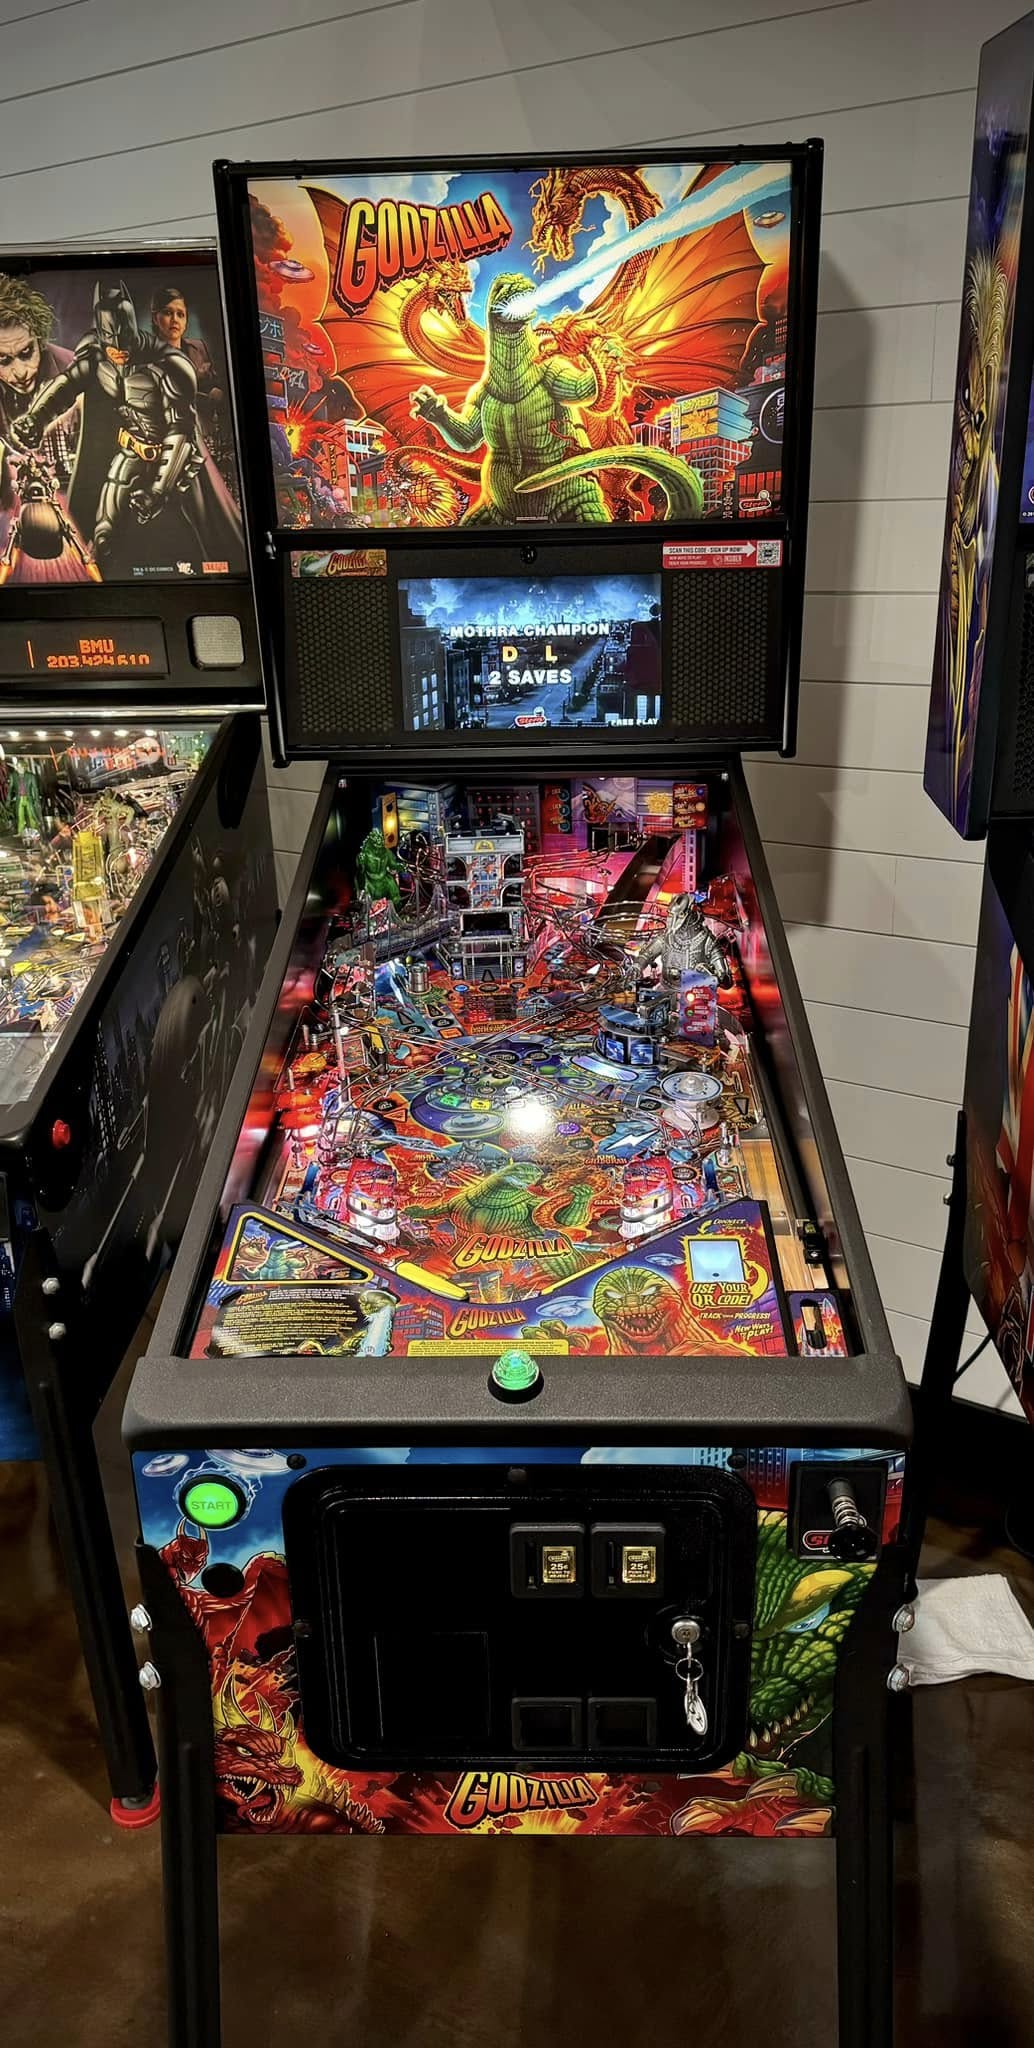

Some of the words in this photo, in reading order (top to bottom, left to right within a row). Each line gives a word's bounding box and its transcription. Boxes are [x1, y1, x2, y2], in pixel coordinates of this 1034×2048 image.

[335, 192, 513, 313] GODZILLA
[450, 625, 517, 638] MOTHRA
[523, 623, 610, 637] CHAMPION
[79, 639, 115, 653] BMU
[502, 646, 518, 663] D
[545, 645, 558, 663] L
[489, 670, 502, 685] 2
[507, 669, 572, 685] SAVES
[636, 718, 658, 727] PLAY
[453, 1233, 573, 1269] GODZILLA
[692, 1283, 716, 1294] USE
[719, 1282, 749, 1293] YOUR
[692, 1294, 716, 1307] QR
[717, 1294, 751, 1305] CODE!
[449, 1308, 526, 1337] GODZILLA
[734, 1312, 770, 1320] PROGRESS!
[747, 1325, 774, 1340] PLAY!
[191, 1501, 232, 1510] START
[550, 1563, 569, 1571] 25¢
[630, 1563, 648, 1571] 25¢
[446, 1771, 598, 1829] GODZILLA
